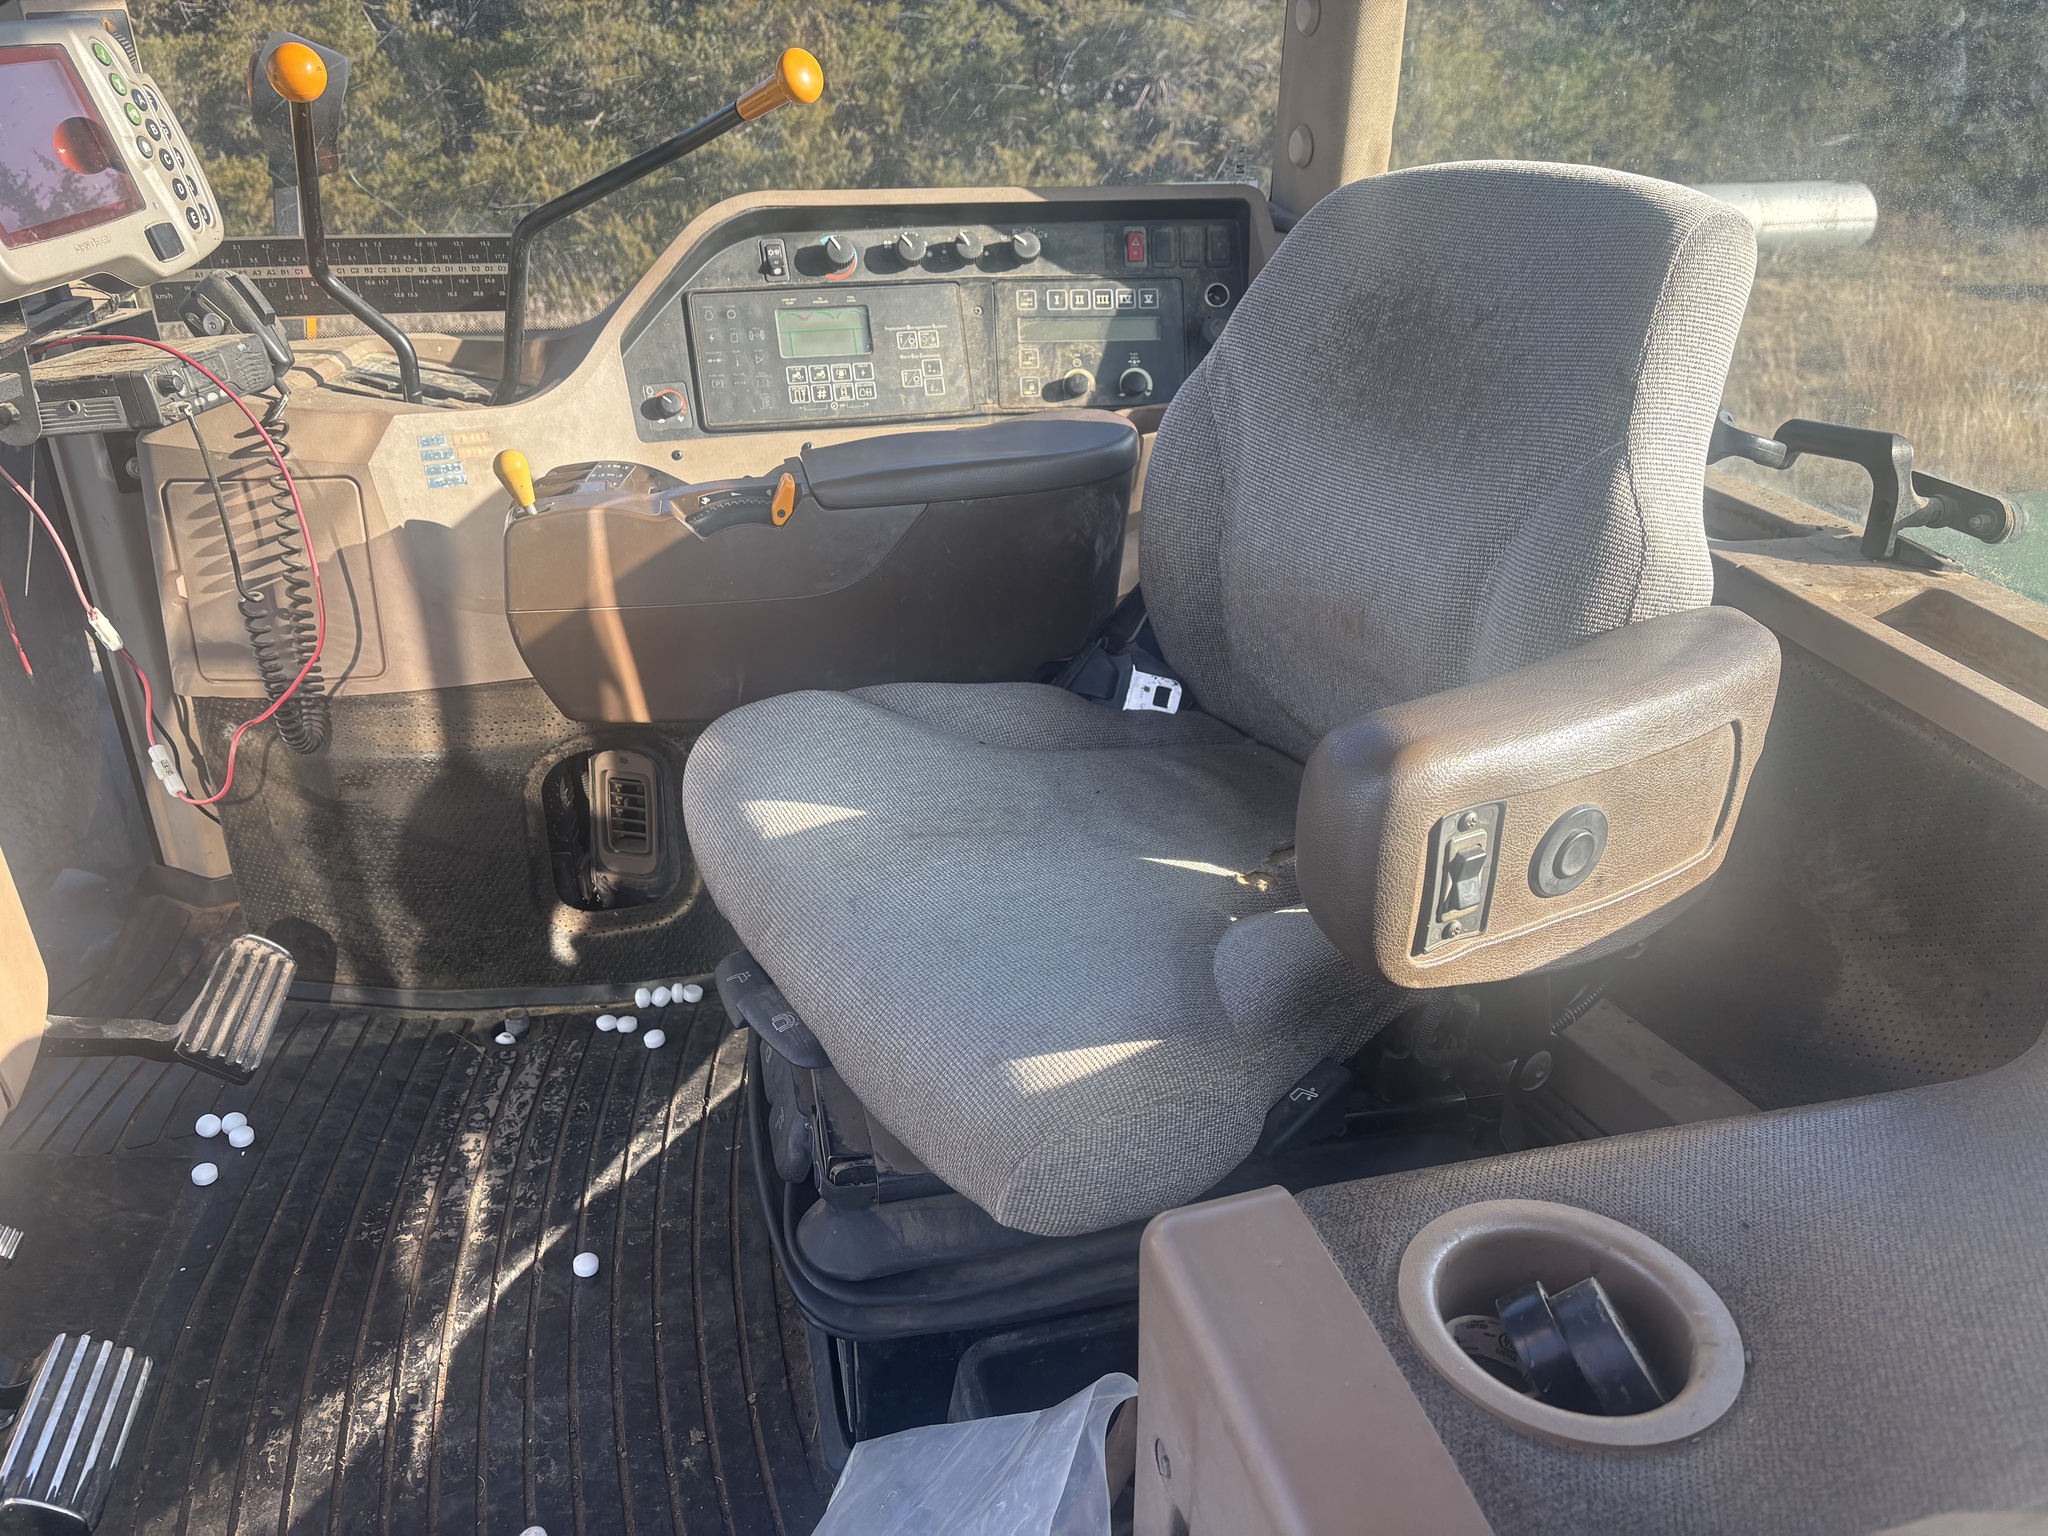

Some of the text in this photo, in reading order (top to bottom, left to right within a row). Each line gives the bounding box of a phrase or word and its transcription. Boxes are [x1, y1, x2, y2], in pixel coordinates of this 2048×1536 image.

[137, 93, 145, 105] A
[150, 124, 158, 135] B
[163, 154, 172, 165] C
[177, 184, 185, 195] D
[191, 209, 208, 224] E J
[73, 239, 93, 256] JOHN
[155, 292, 173, 300] km/h
[1054, 294, 1153, 305] I II III IV V
